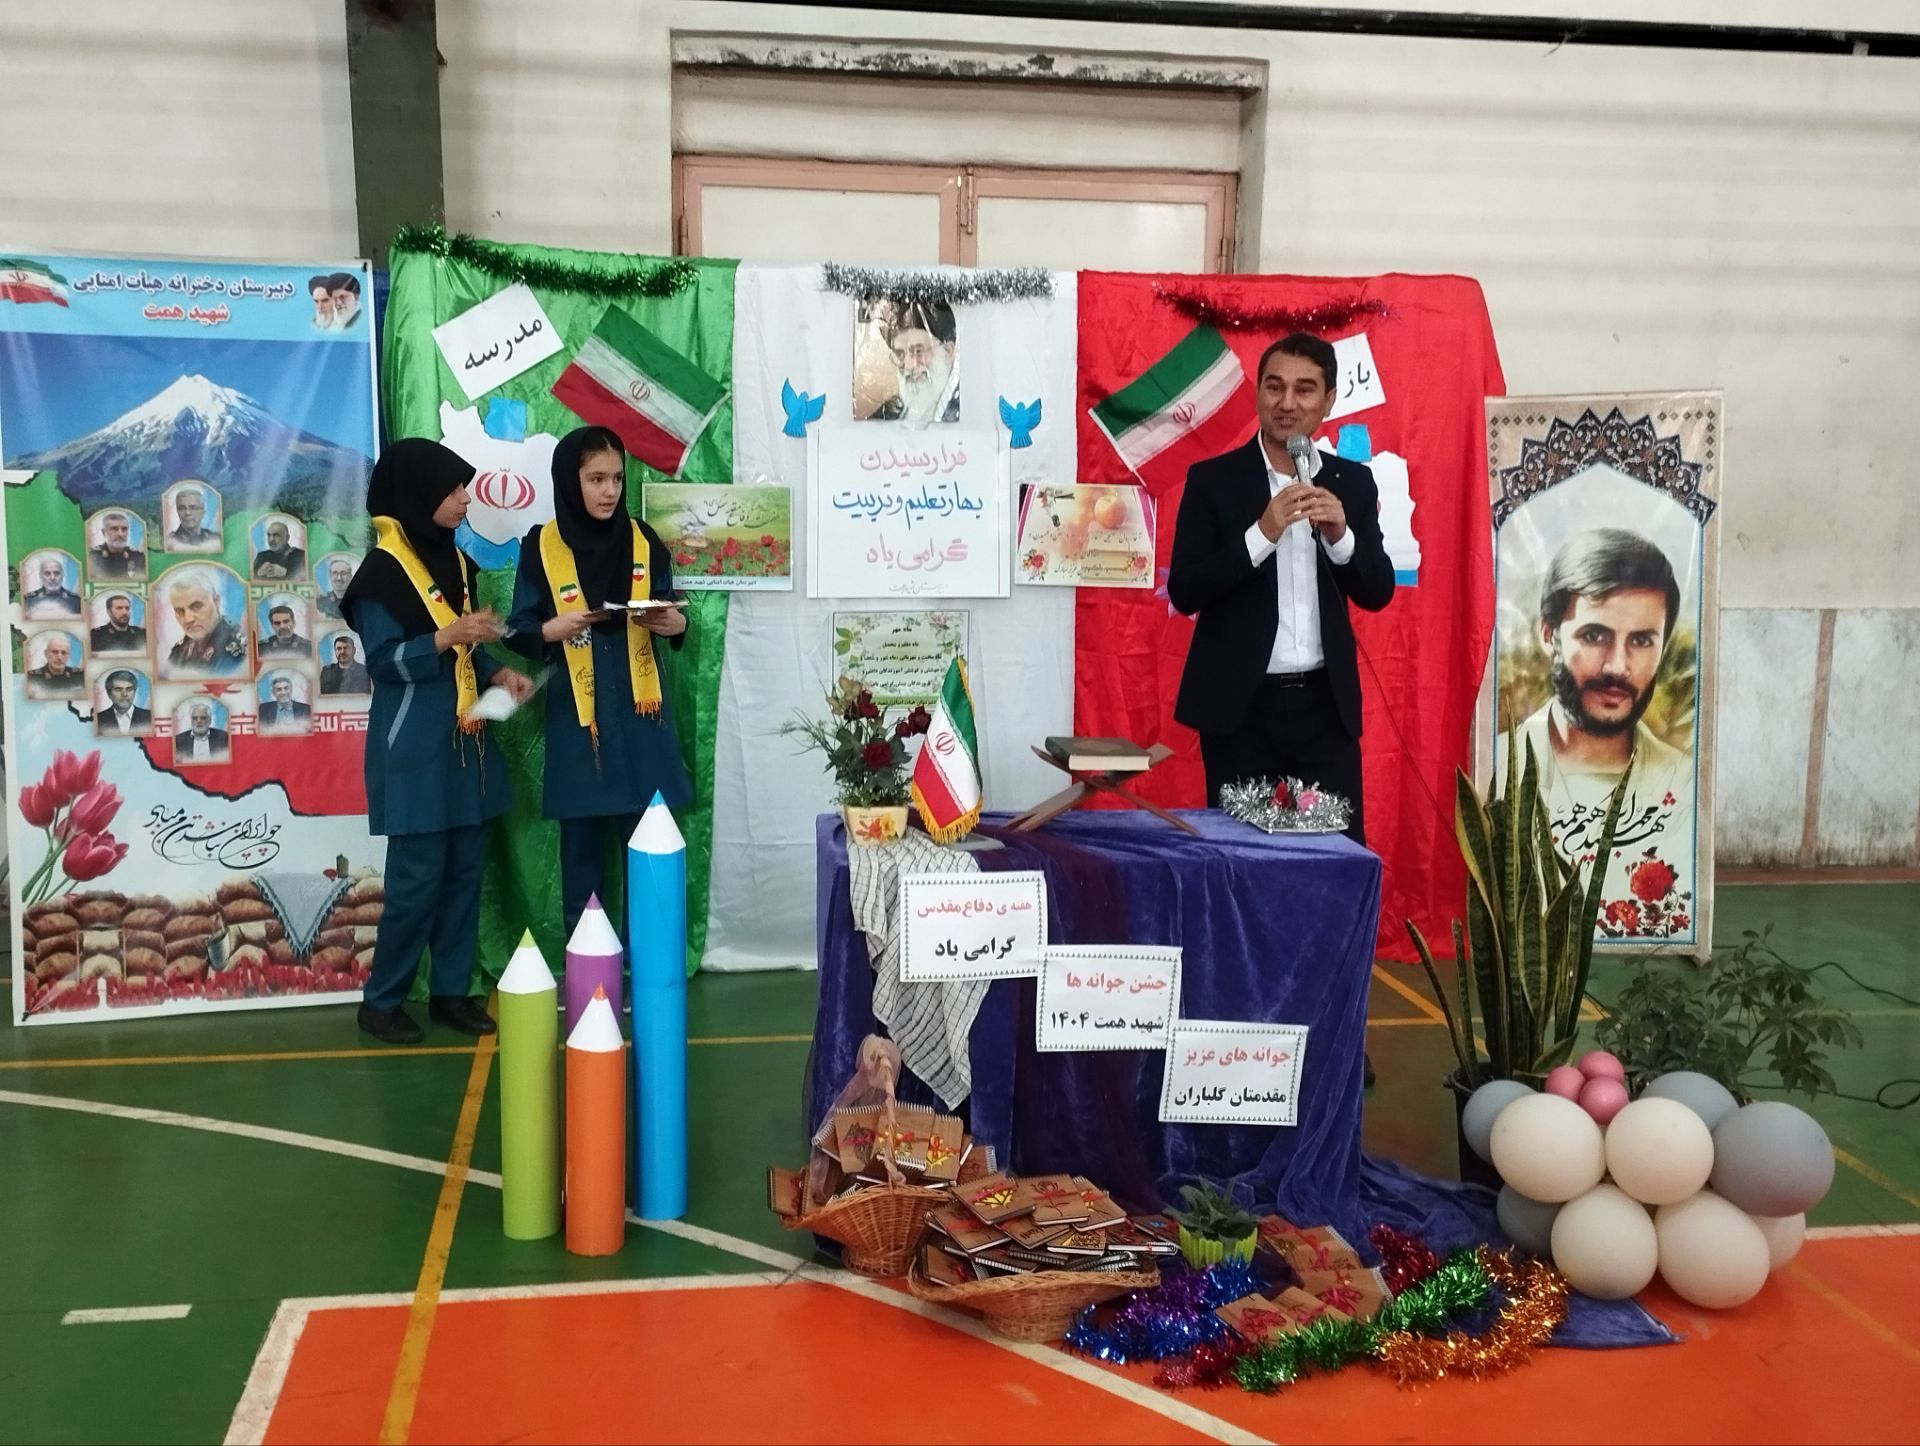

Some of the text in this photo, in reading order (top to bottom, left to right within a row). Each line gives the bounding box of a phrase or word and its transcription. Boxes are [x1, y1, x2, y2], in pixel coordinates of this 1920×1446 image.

[73, 272, 122, 291] امنایی
[168, 273, 225, 295] دخترانه
[230, 277, 294, 299] دبیرستان
[144, 303, 229, 324] شهید همت
[464, 318, 543, 370] مدرسه
[1344, 362, 1371, 399] باز
[833, 481, 984, 530] بهار تعلیم و تربیت
[866, 533, 968, 572] گرامی باد
[917, 897, 1032, 918] هفته ی دفاع مقدس
[935, 935, 1016, 962] گرامی باد
[1066, 972, 1167, 995] جشن جوانه ها
[1051, 1011, 1164, 1033] شهید همت ۱۴۰۴
[1183, 1046, 1291, 1067] جوانه های عزیز
[1174, 1085, 1287, 1107] مقدمتان گلباران
